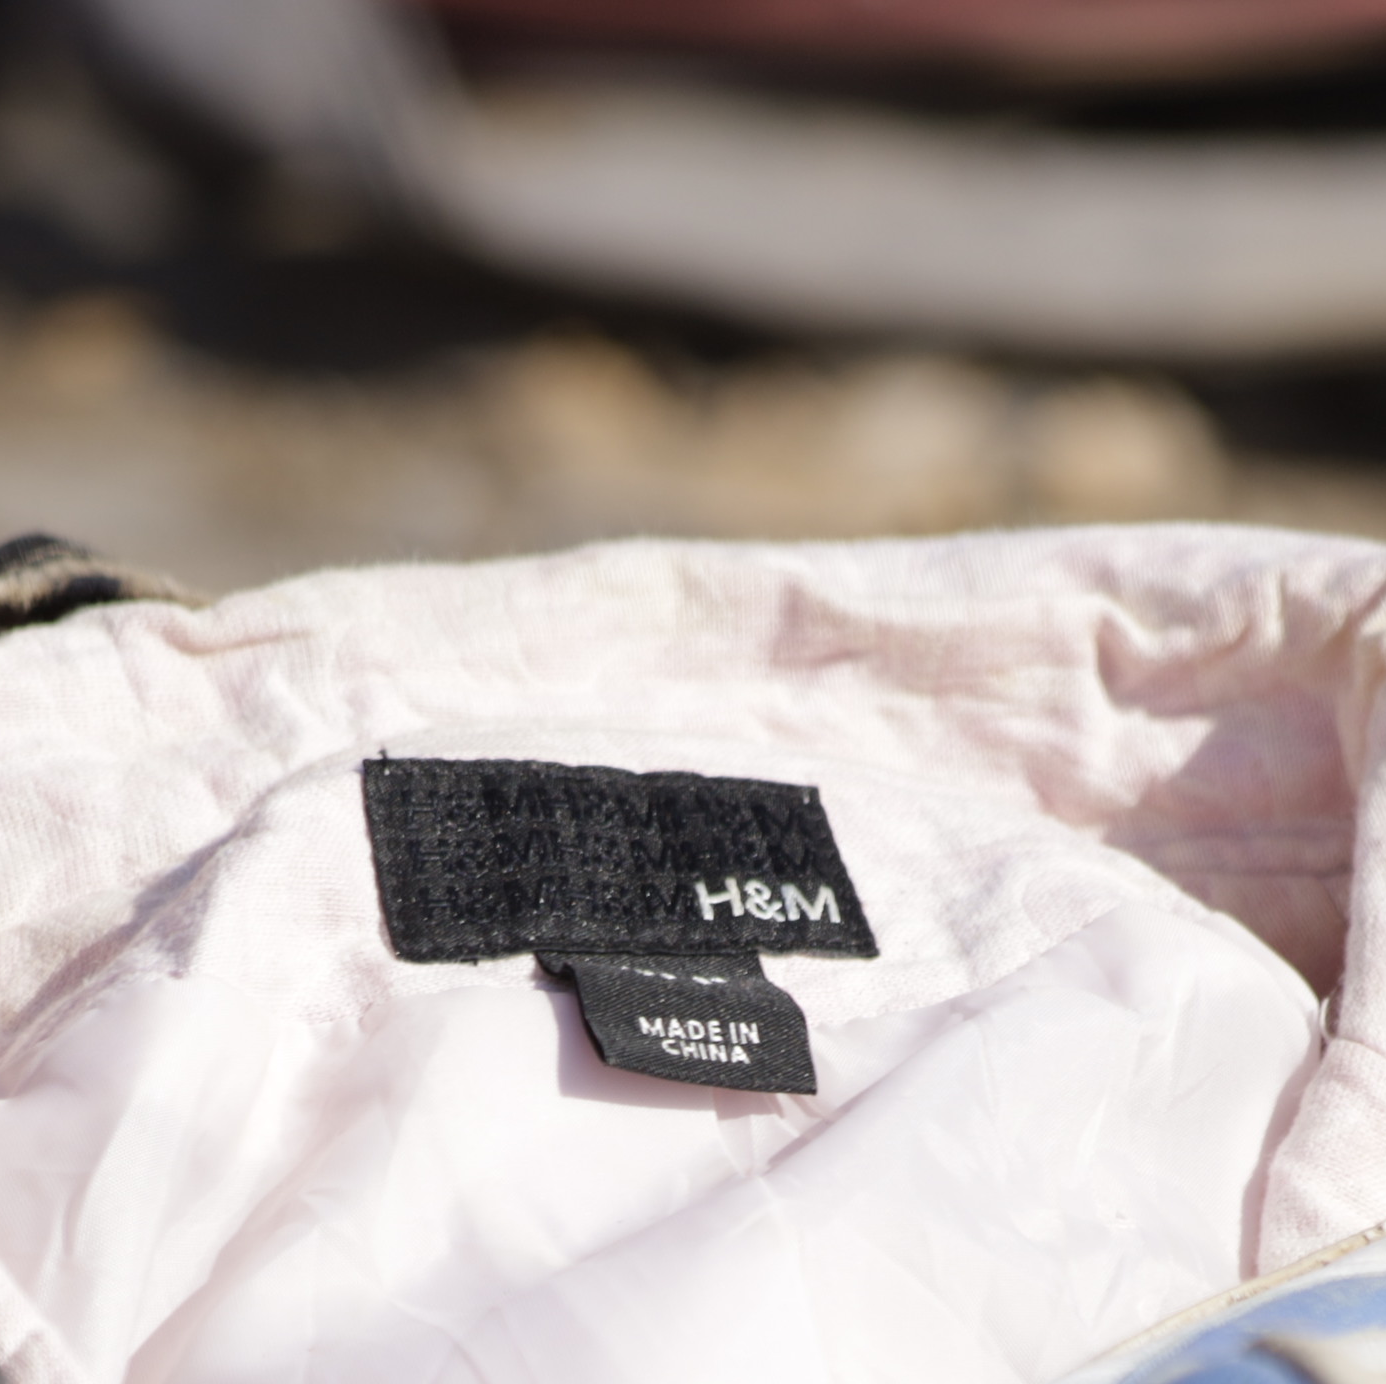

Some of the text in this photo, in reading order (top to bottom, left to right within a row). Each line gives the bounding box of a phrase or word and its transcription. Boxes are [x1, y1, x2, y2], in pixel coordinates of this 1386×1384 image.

[695, 876, 842, 924] H&M
[638, 1016, 760, 1044] MADE IN
[662, 1039, 750, 1064] CHINA
